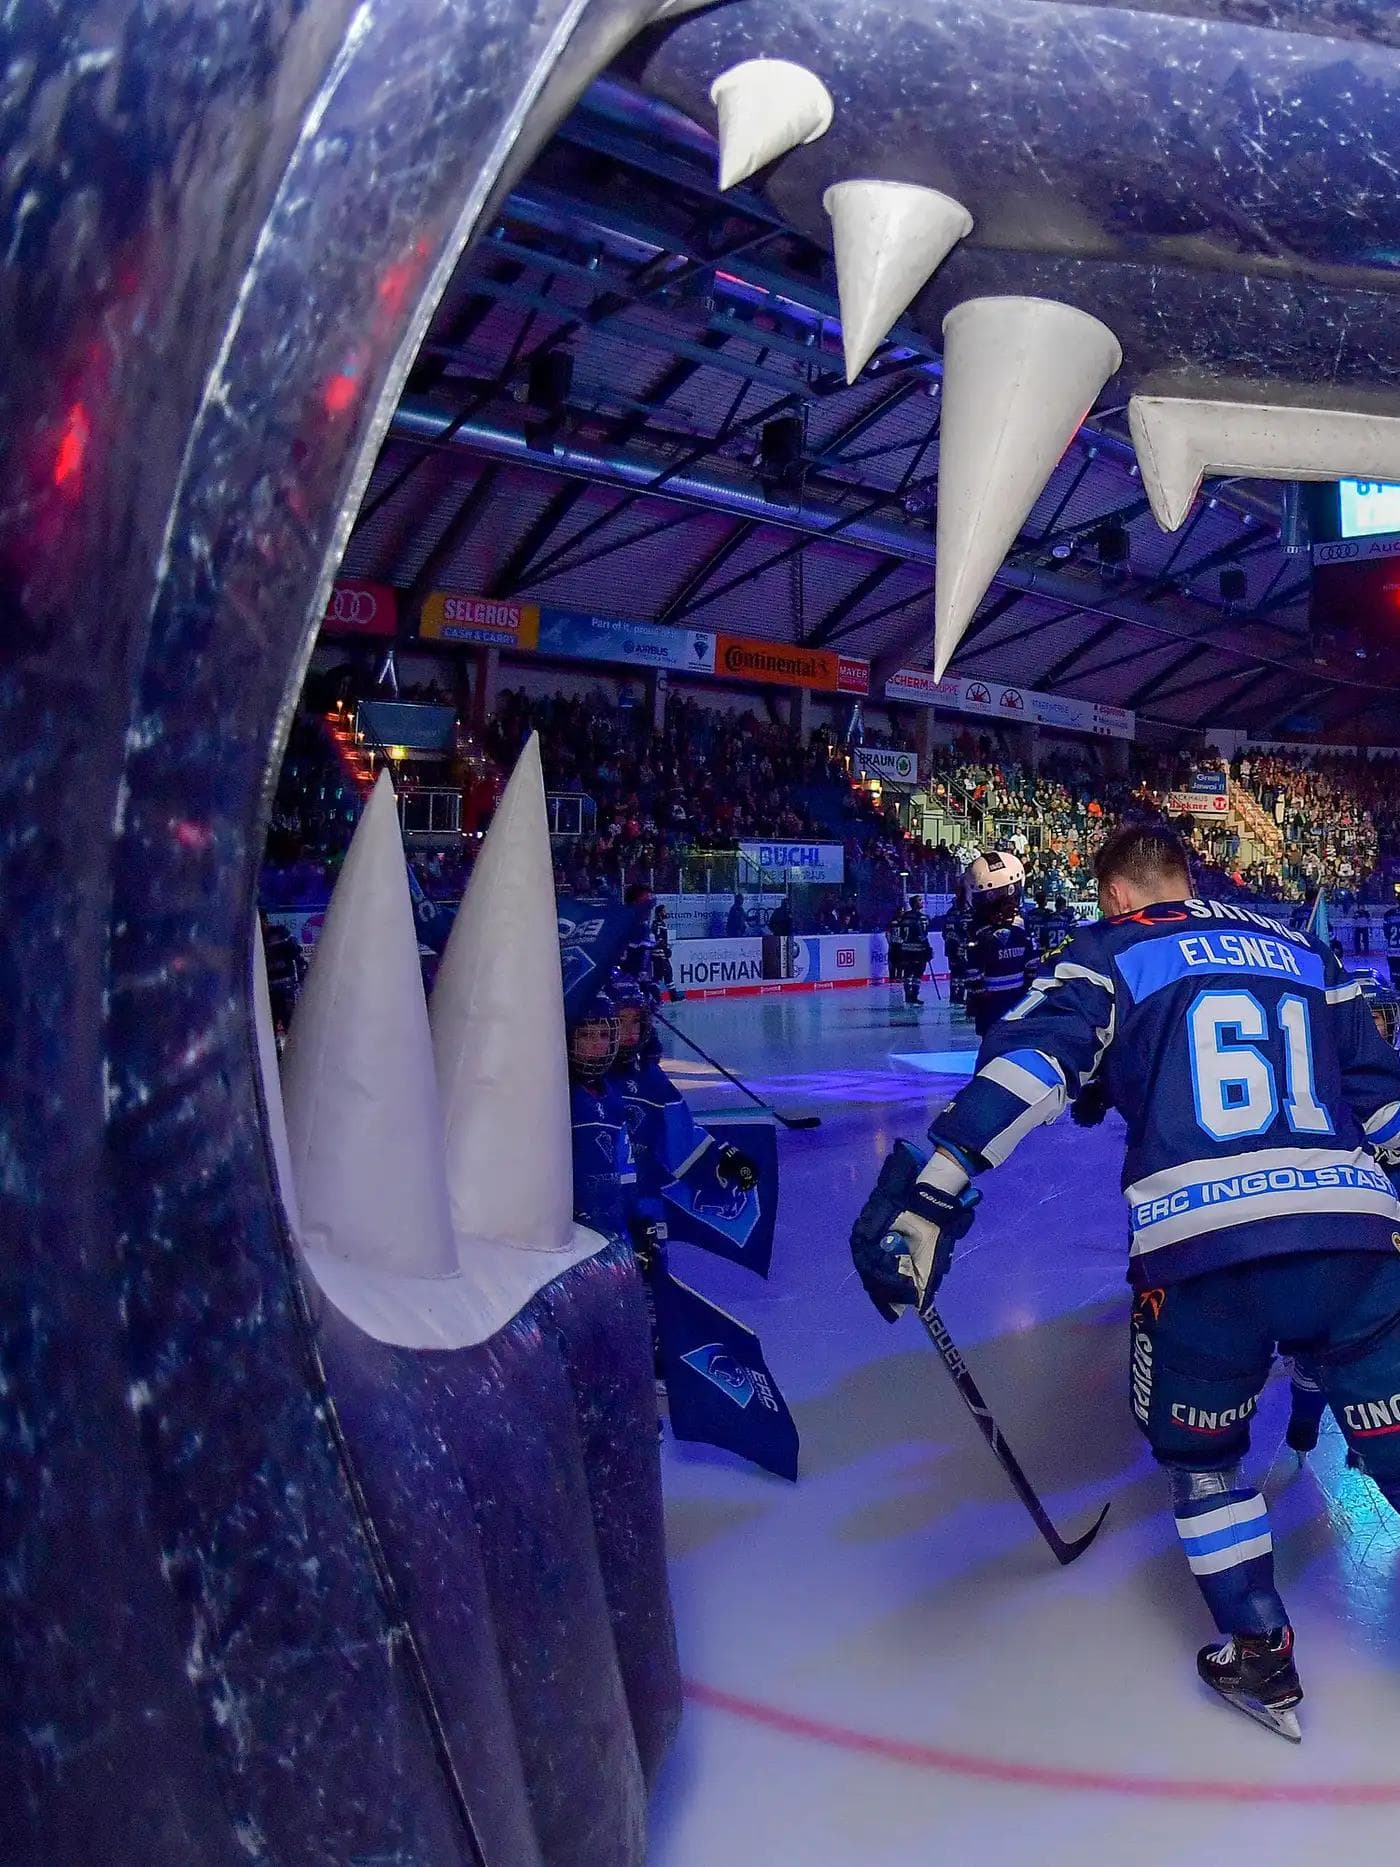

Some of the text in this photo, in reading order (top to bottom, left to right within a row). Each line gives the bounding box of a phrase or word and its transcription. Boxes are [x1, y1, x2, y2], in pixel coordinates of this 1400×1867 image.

[443, 598, 520, 628] SELGROS
[725, 646, 817, 677] Continental
[839, 667, 868, 679] MAYER
[860, 753, 896, 767] BRAUN
[760, 846, 820, 867] BÜCHL
[1183, 899, 1312, 948] SATURN
[839, 952, 854, 966] DB
[1179, 935, 1301, 976] ELSNER
[1187, 989, 1335, 1142] 61
[1137, 1166, 1396, 1226] ERC INGOLSTADT
